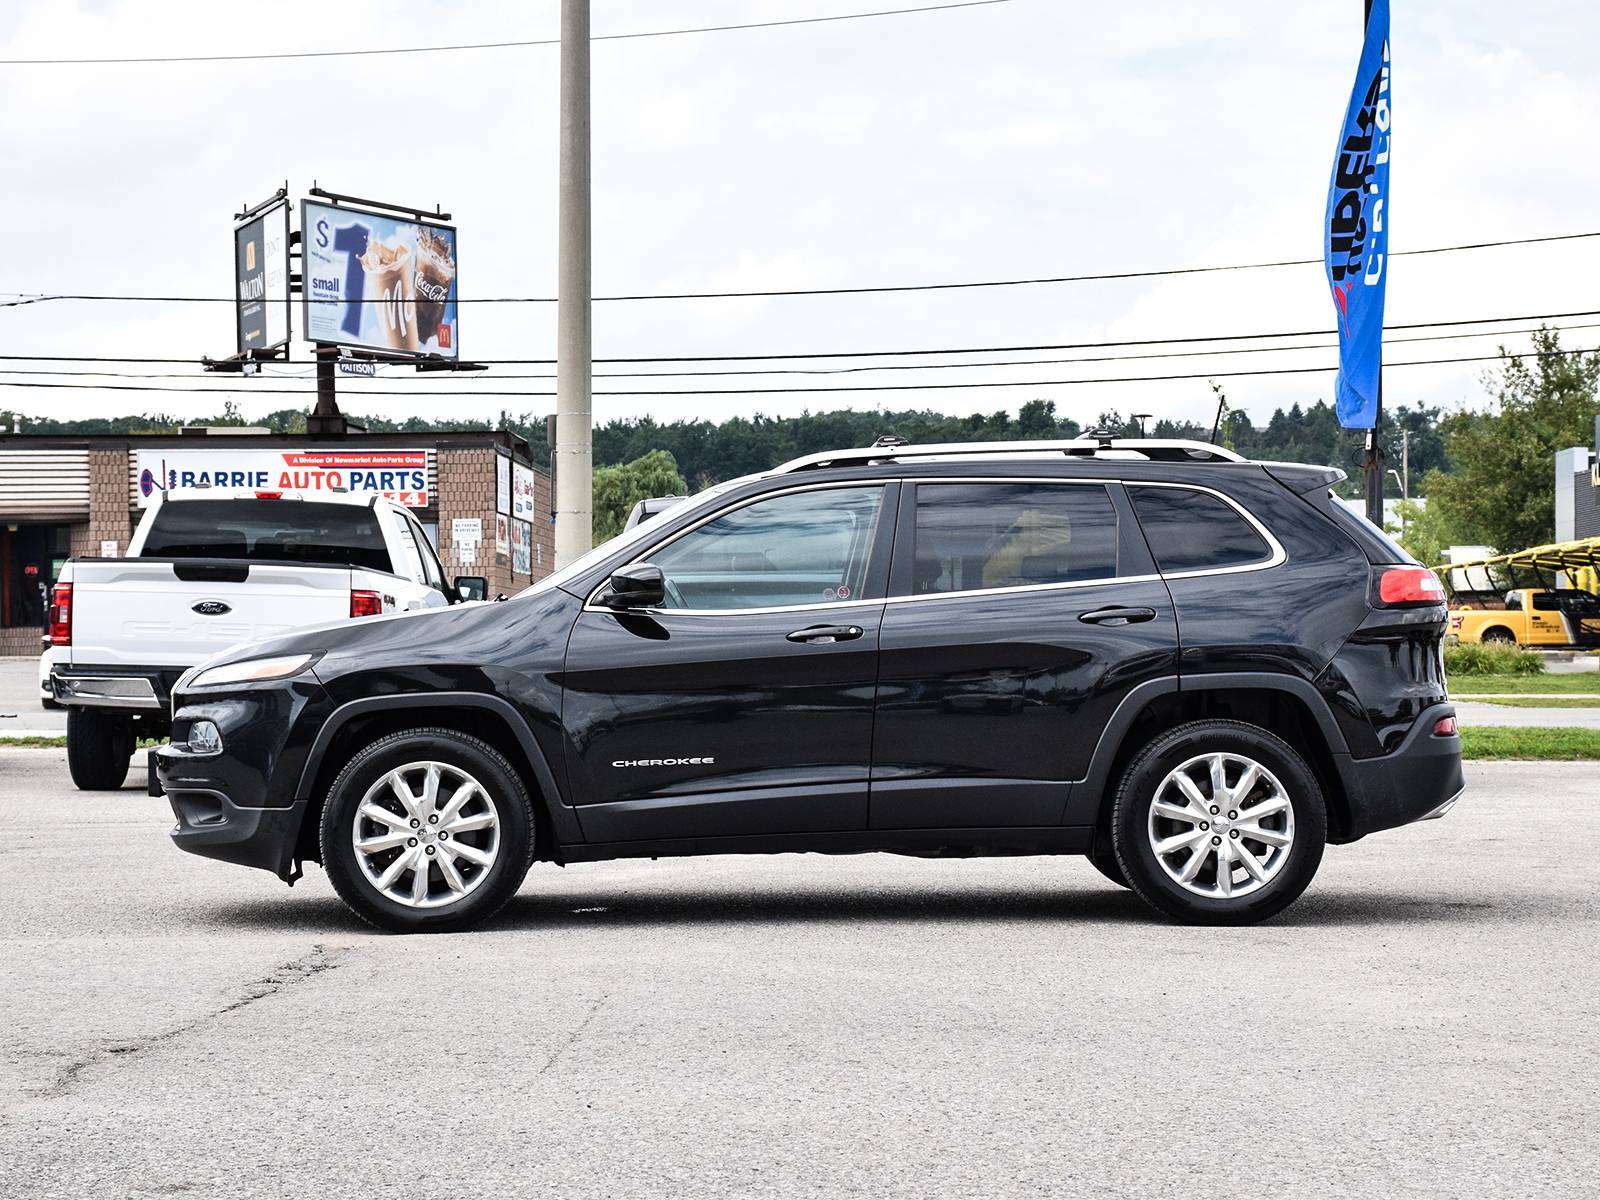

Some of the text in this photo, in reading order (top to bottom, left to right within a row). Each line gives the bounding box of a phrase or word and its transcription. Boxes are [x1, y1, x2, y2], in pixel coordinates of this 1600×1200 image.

[312, 277, 340, 293] small
[299, 456, 324, 464] Division
[325, 456, 333, 464] Of
[334, 456, 371, 464] Newmarket
[372, 456, 387, 464] Auto
[405, 456, 424, 465] Group
[181, 471, 425, 491] BARRIE AUTO PARTS
[200, 601, 223, 613] Ford
[612, 757, 715, 768] CHEROKEE
